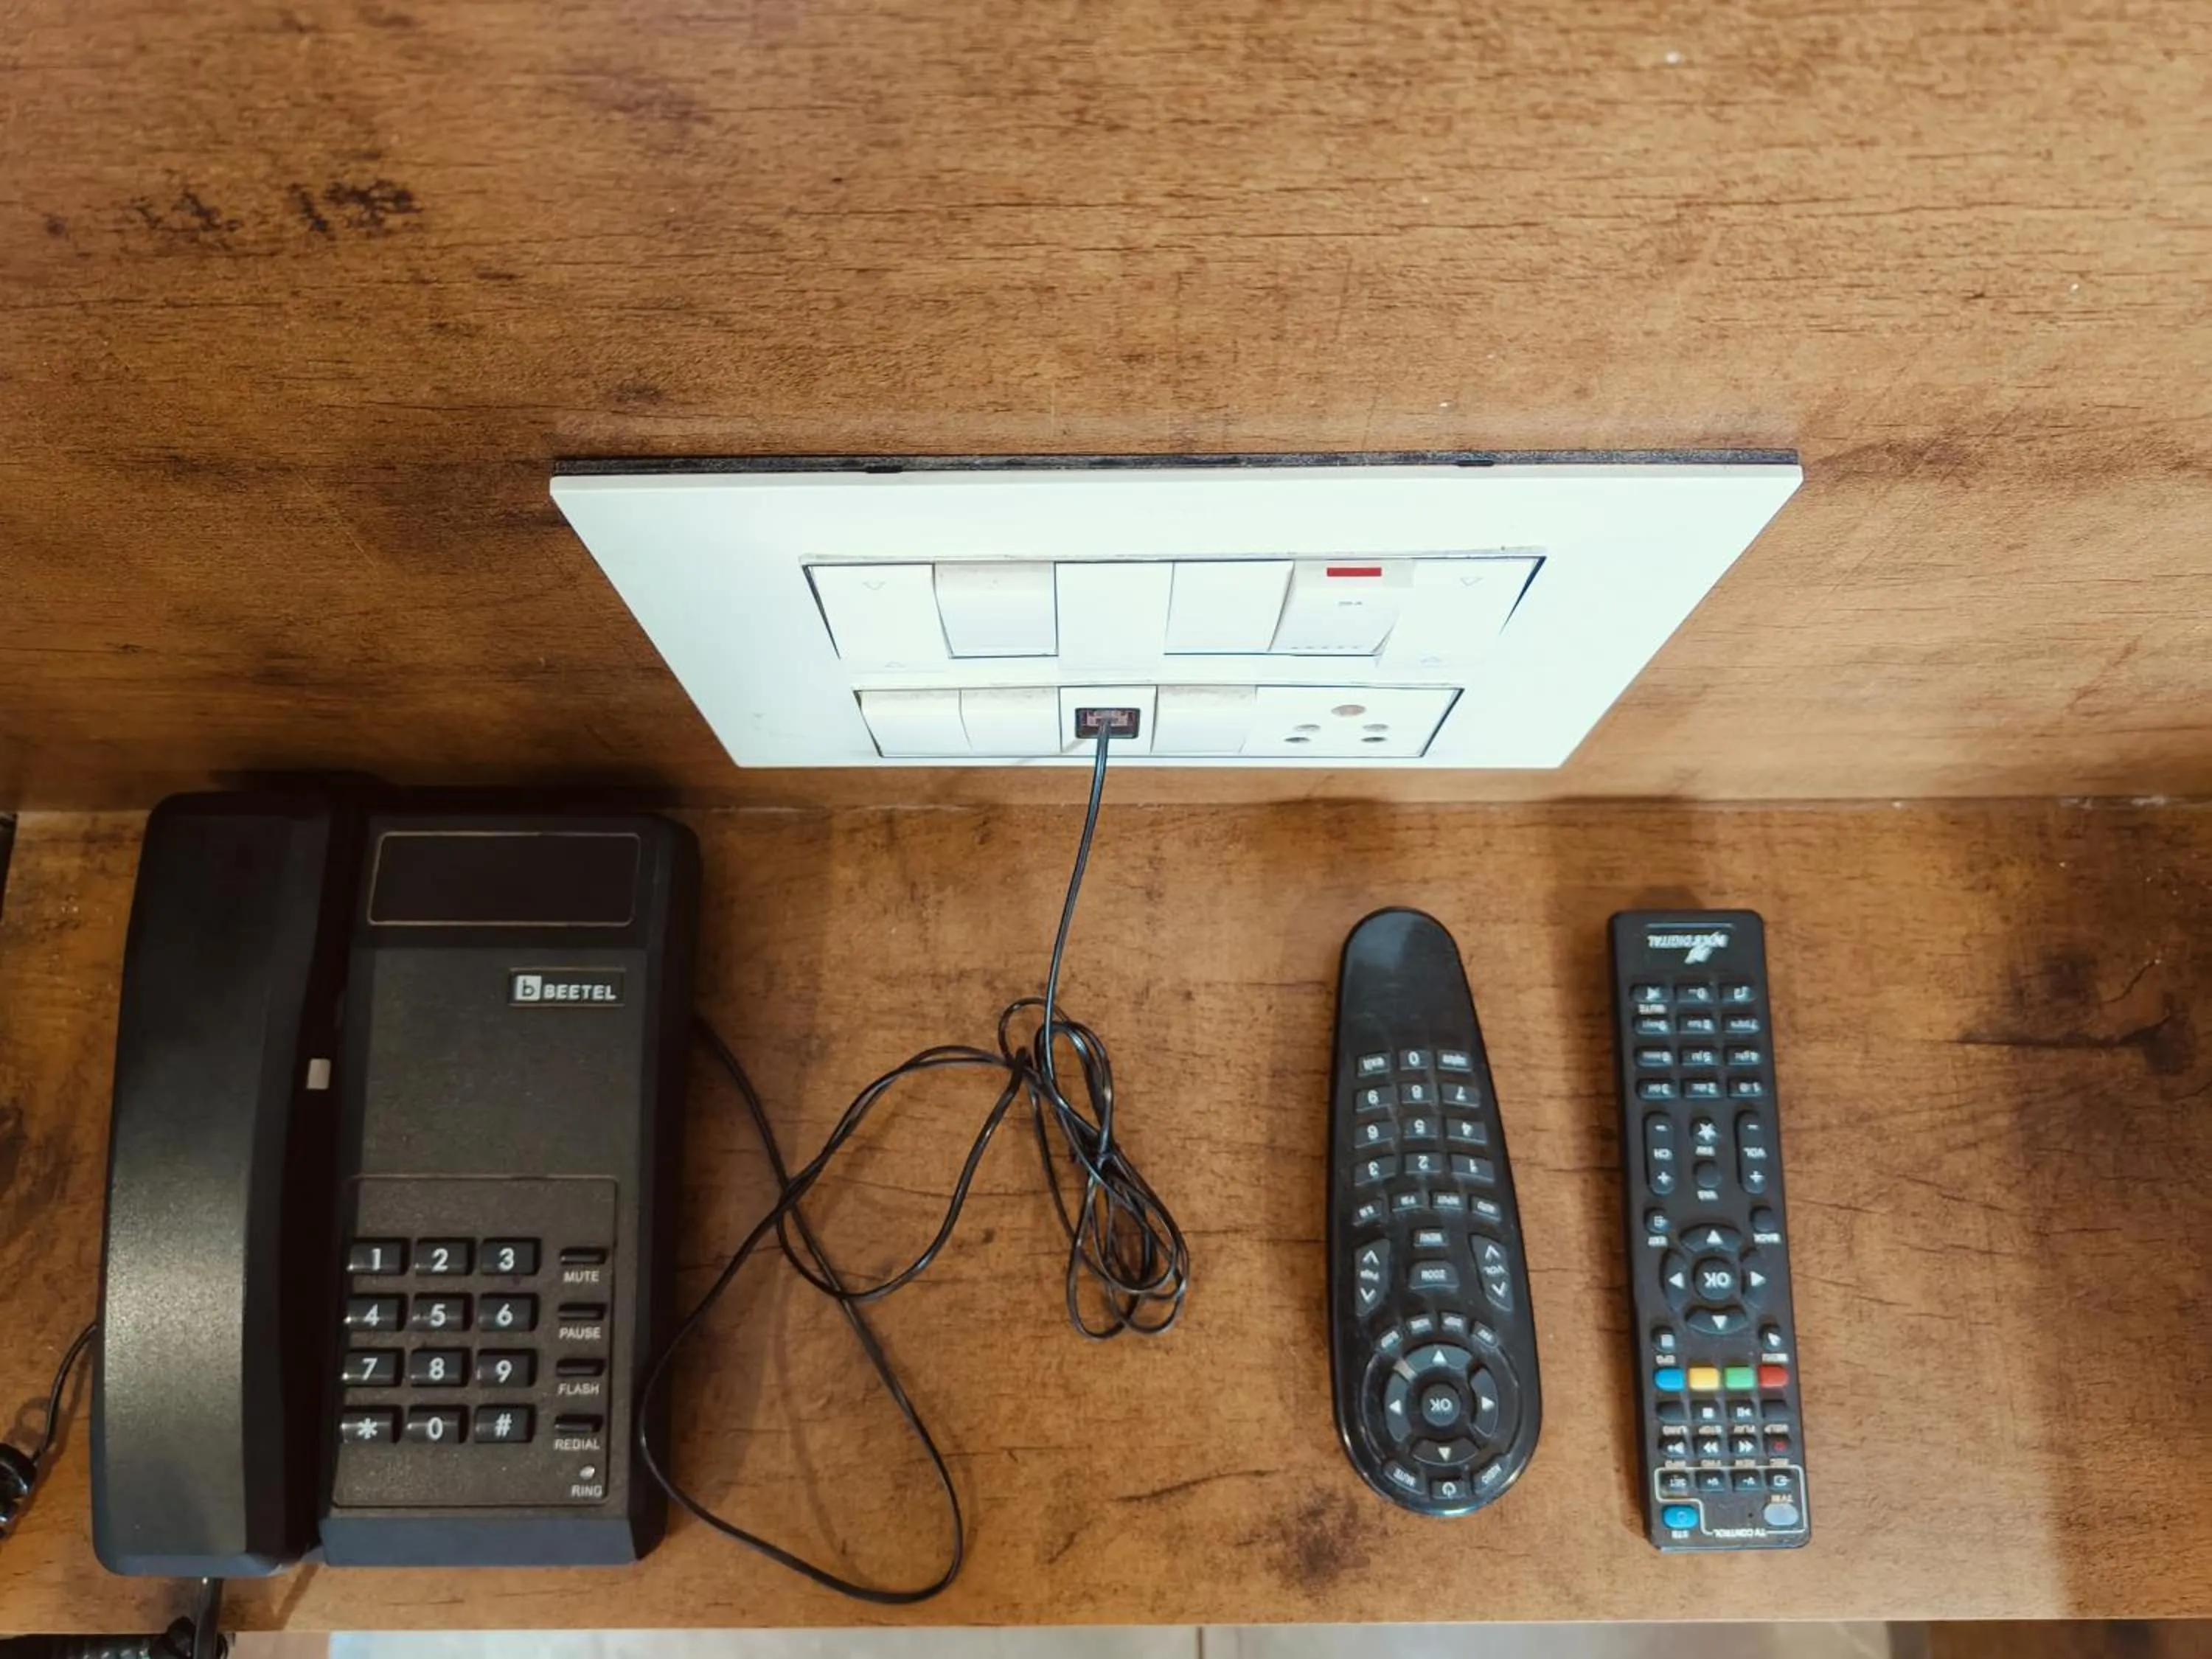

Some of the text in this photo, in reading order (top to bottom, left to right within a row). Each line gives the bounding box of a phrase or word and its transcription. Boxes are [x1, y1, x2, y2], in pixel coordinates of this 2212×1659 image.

[543, 984, 616, 1001] BEETEL
[1409, 1052, 1419, 1065] 0
[1368, 1090, 1379, 1105] 9
[1411, 1086, 1422, 1099] 8
[1455, 1086, 1466, 1099] 7
[1367, 1125, 1379, 1139] 6
[1414, 1120, 1425, 1134] 5
[1461, 1123, 1472, 1136] 4
[1743, 1147, 1767, 1158] VOL
[1368, 1162, 1379, 1176] 3
[1418, 1156, 1429, 1169] 2
[1469, 1158, 1478, 1172] 1
[371, 1248, 381, 1270] 1
[433, 1248, 448, 1271] 2
[499, 1248, 515, 1270] 3
[563, 1271, 599, 1283] MUTE
[1421, 1270, 1445, 1280] ZOOM
[1484, 1265, 1504, 1276] VOL
[1704, 1273, 1731, 1288] OK
[365, 1304, 379, 1325] 4
[431, 1304, 446, 1326] 5
[497, 1304, 512, 1326] 6
[559, 1327, 601, 1340] PAUSE
[362, 1358, 378, 1380] 7
[429, 1357, 444, 1380] 8
[495, 1360, 511, 1382] 9
[558, 1383, 599, 1395] FLASH
[1430, 1399, 1453, 1411] OK
[428, 1417, 442, 1440] 0
[495, 1414, 512, 1436] #
[554, 1439, 599, 1450] REDIAL
[571, 1486, 602, 1498] RING
[1714, 1529, 1766, 1538] TV CONTROL
